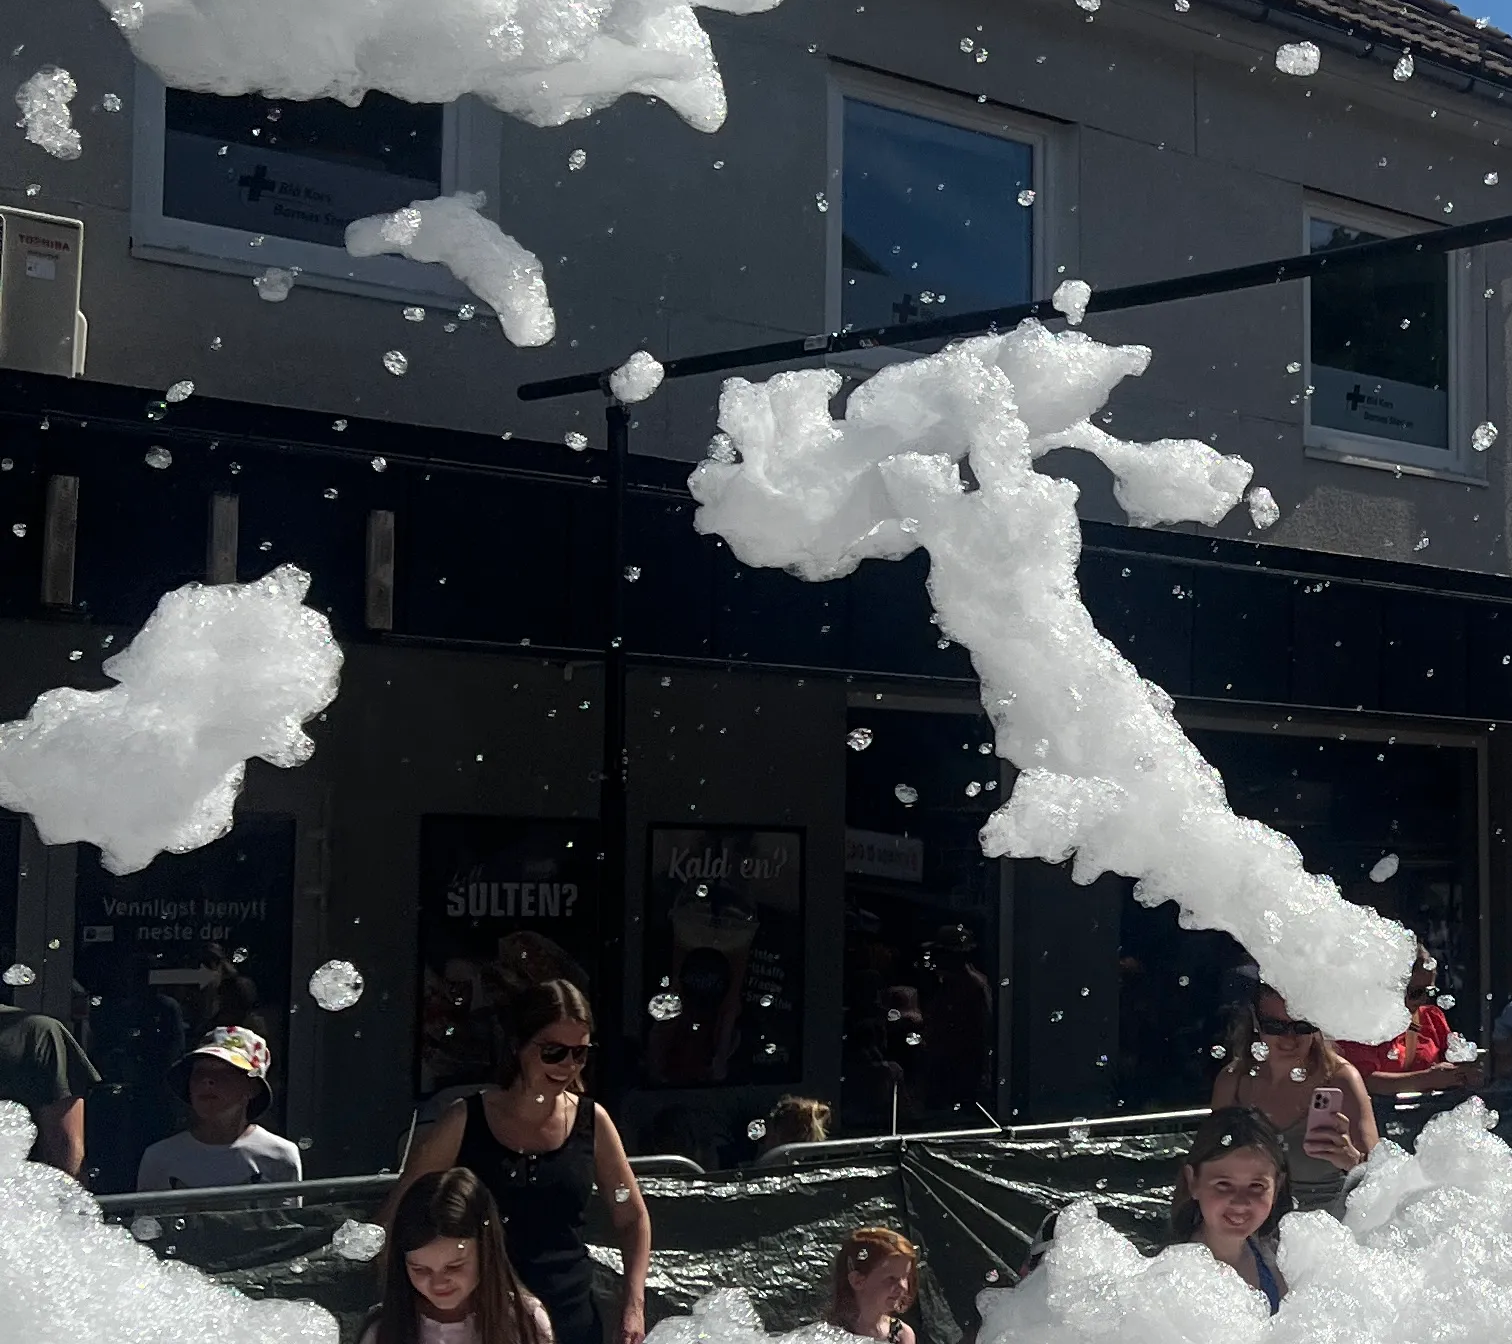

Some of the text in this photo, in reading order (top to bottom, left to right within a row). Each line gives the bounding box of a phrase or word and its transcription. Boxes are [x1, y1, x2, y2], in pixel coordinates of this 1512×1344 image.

[667, 845, 732, 884] Kald
[102, 896, 268, 924] Vennligst benytt
[446, 881, 579, 918] SULTEN?
[137, 923, 193, 941] neste
